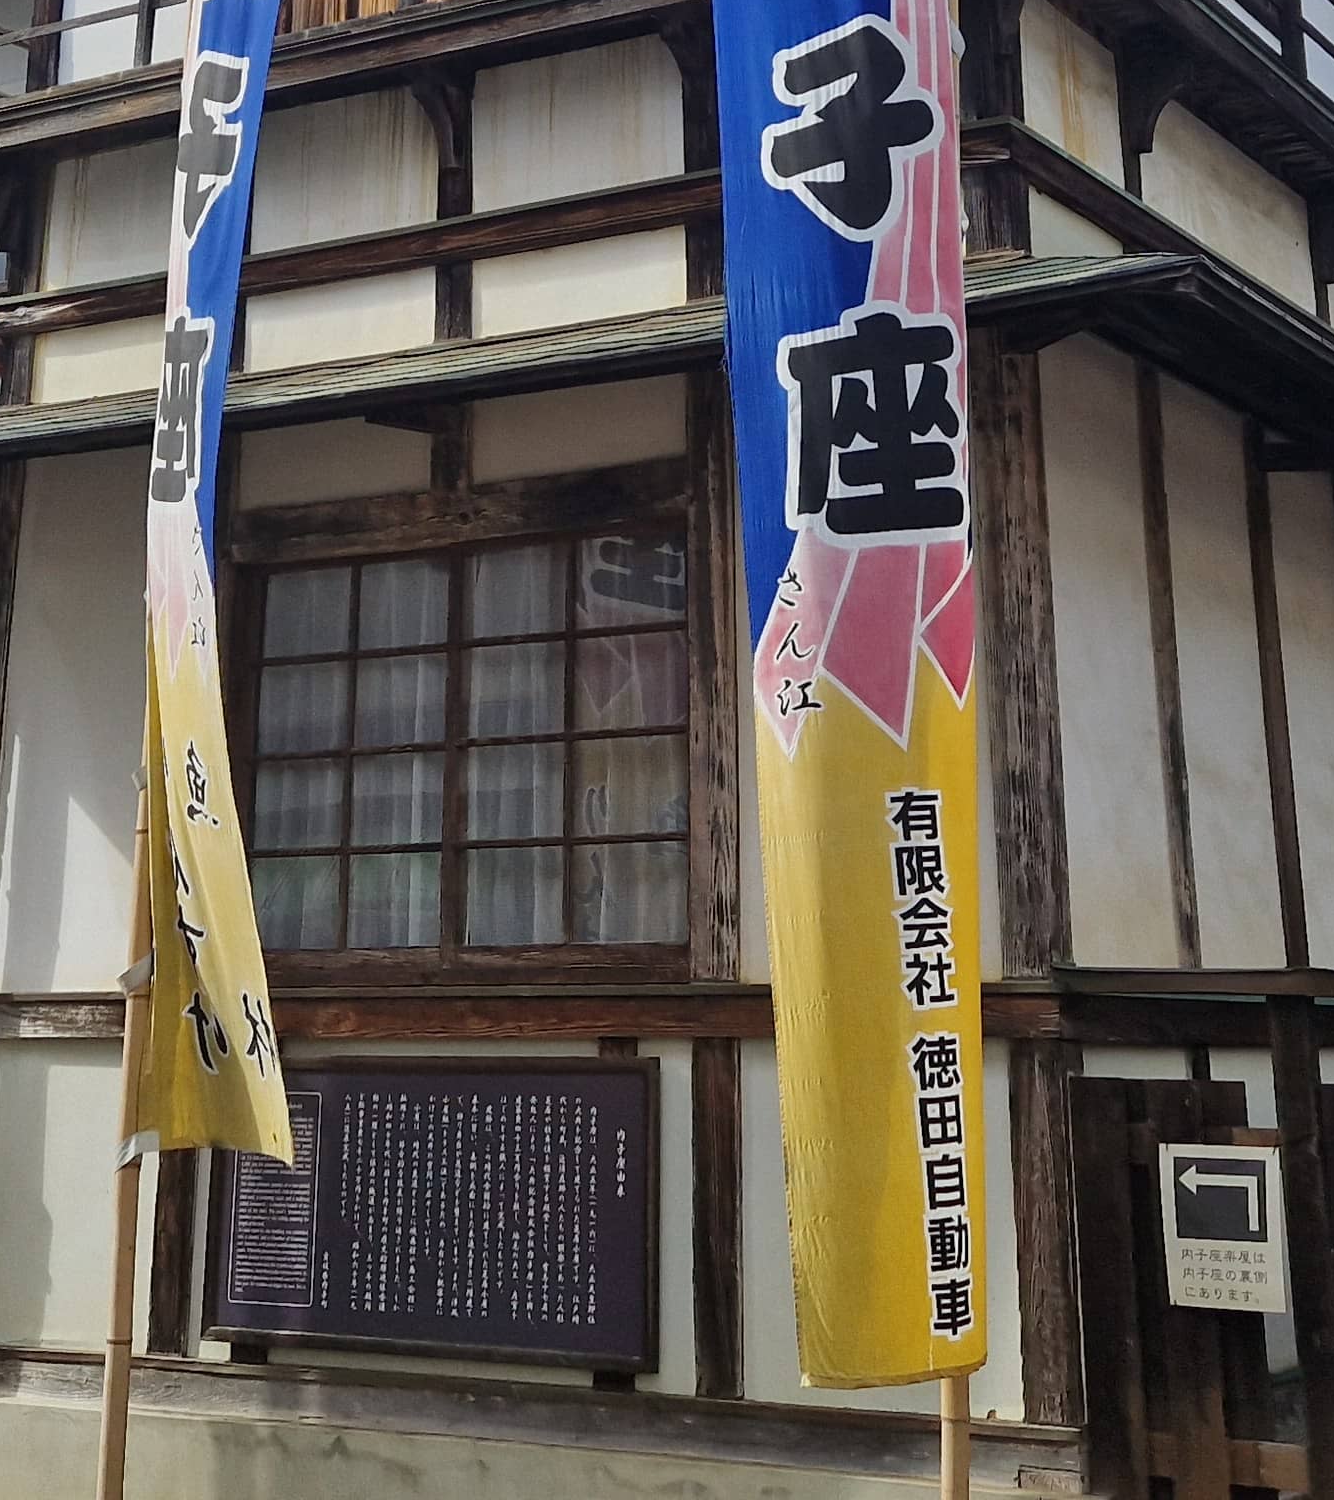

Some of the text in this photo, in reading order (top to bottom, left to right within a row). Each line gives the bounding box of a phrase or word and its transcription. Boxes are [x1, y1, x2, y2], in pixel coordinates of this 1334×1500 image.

[774, 565, 827, 714] さん江
[889, 788, 973, 1337] 有限会社 徳田自動車
[1181, 1247, 1266, 1264] 内子座楽屋は
[1182, 1267, 1268, 1284] 内子座の裏側
[1184, 1286, 1261, 1304] にあります。
